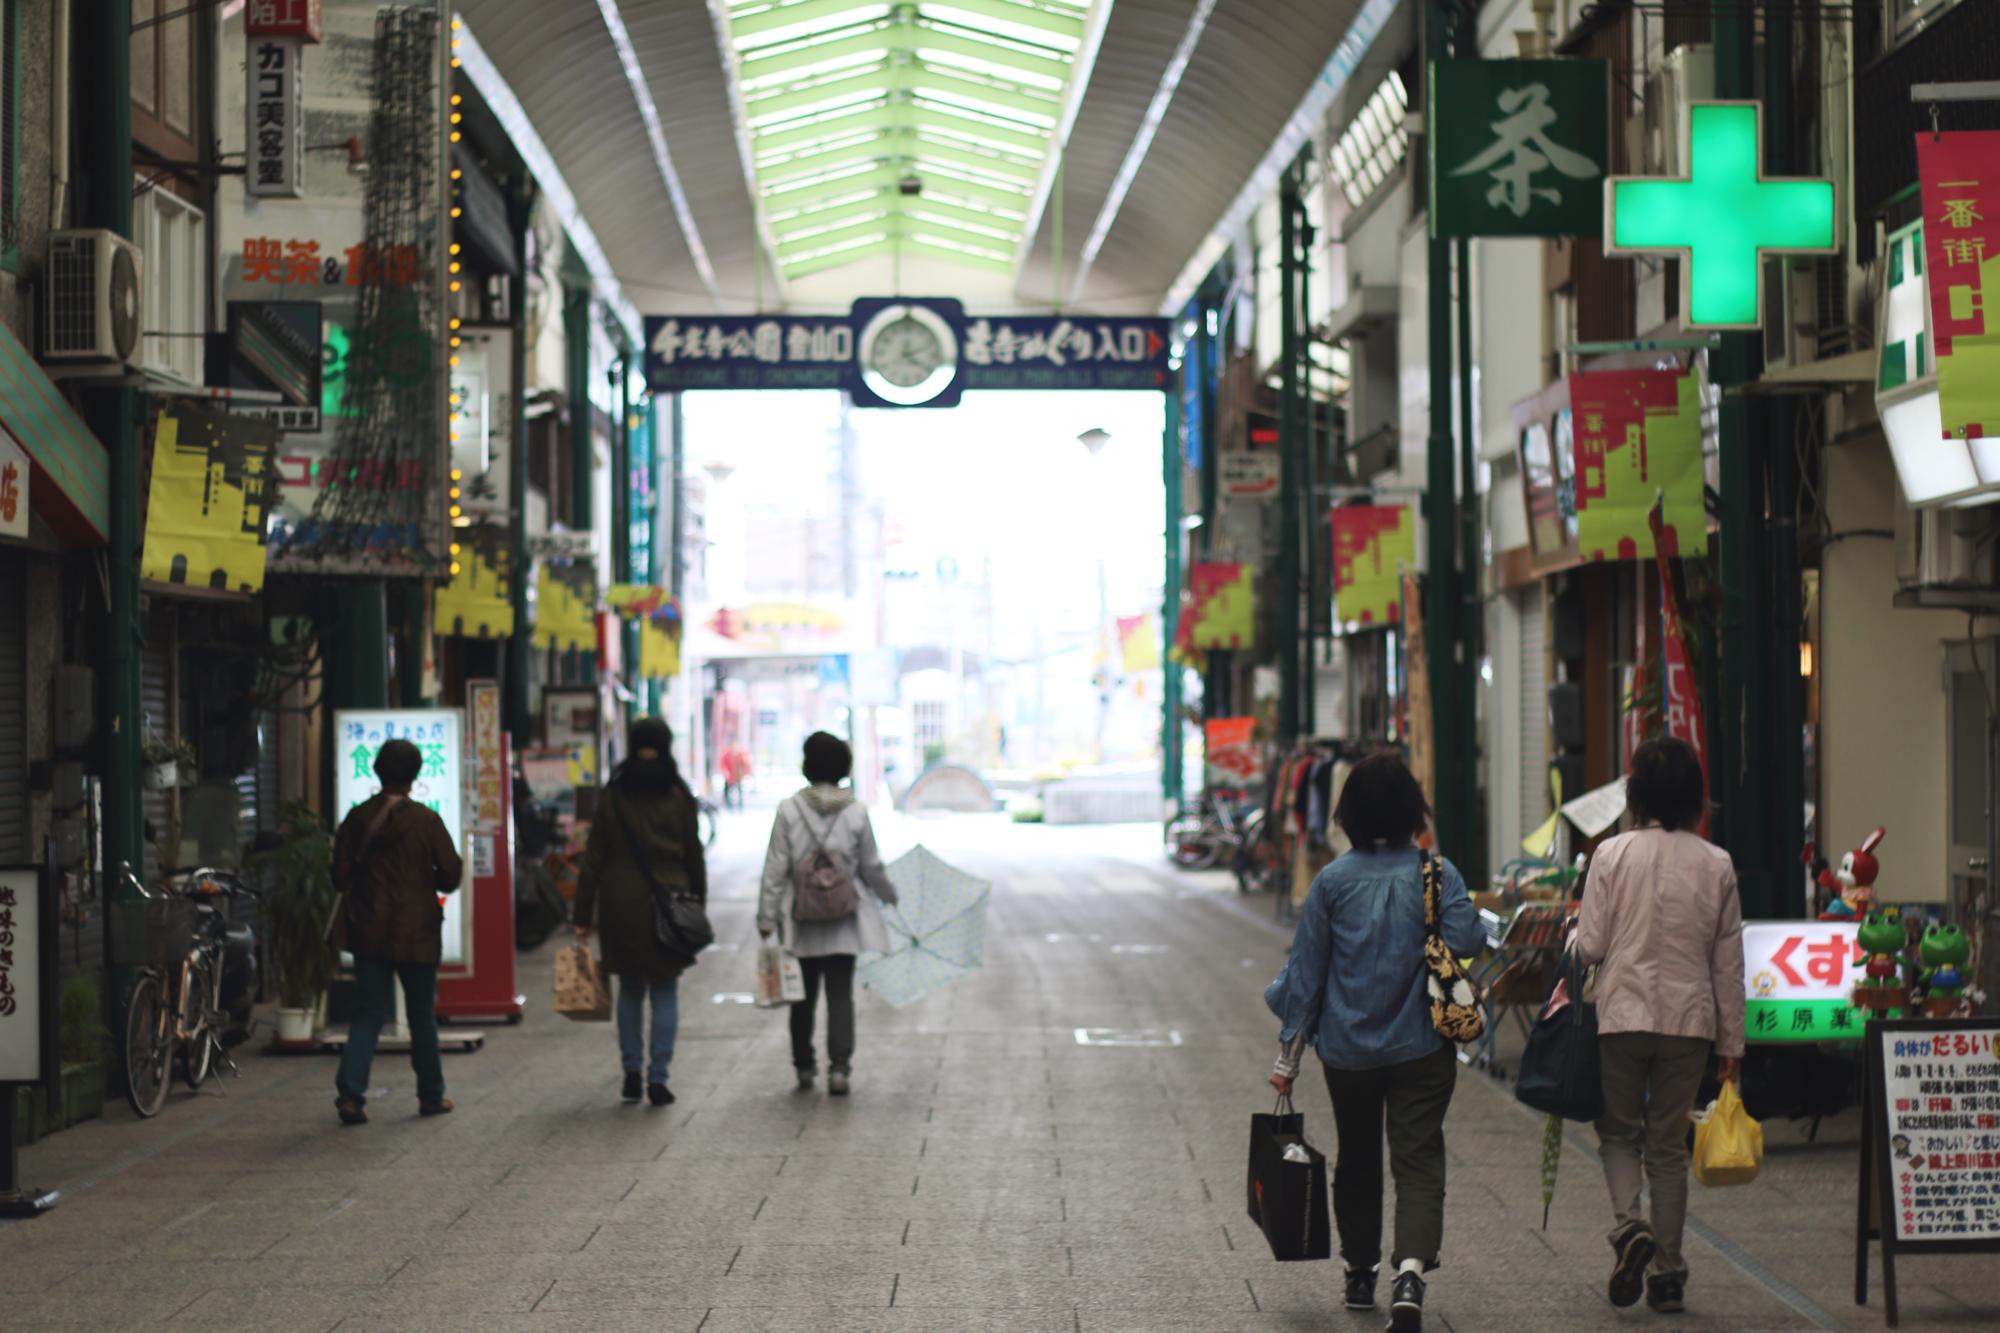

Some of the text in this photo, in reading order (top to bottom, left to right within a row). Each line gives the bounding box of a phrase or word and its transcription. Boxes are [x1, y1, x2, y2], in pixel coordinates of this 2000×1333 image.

[257, 42, 285, 186] カコ美容室
[1447, 82, 1600, 218] 茶
[1936, 180, 1985, 267] 一番街
